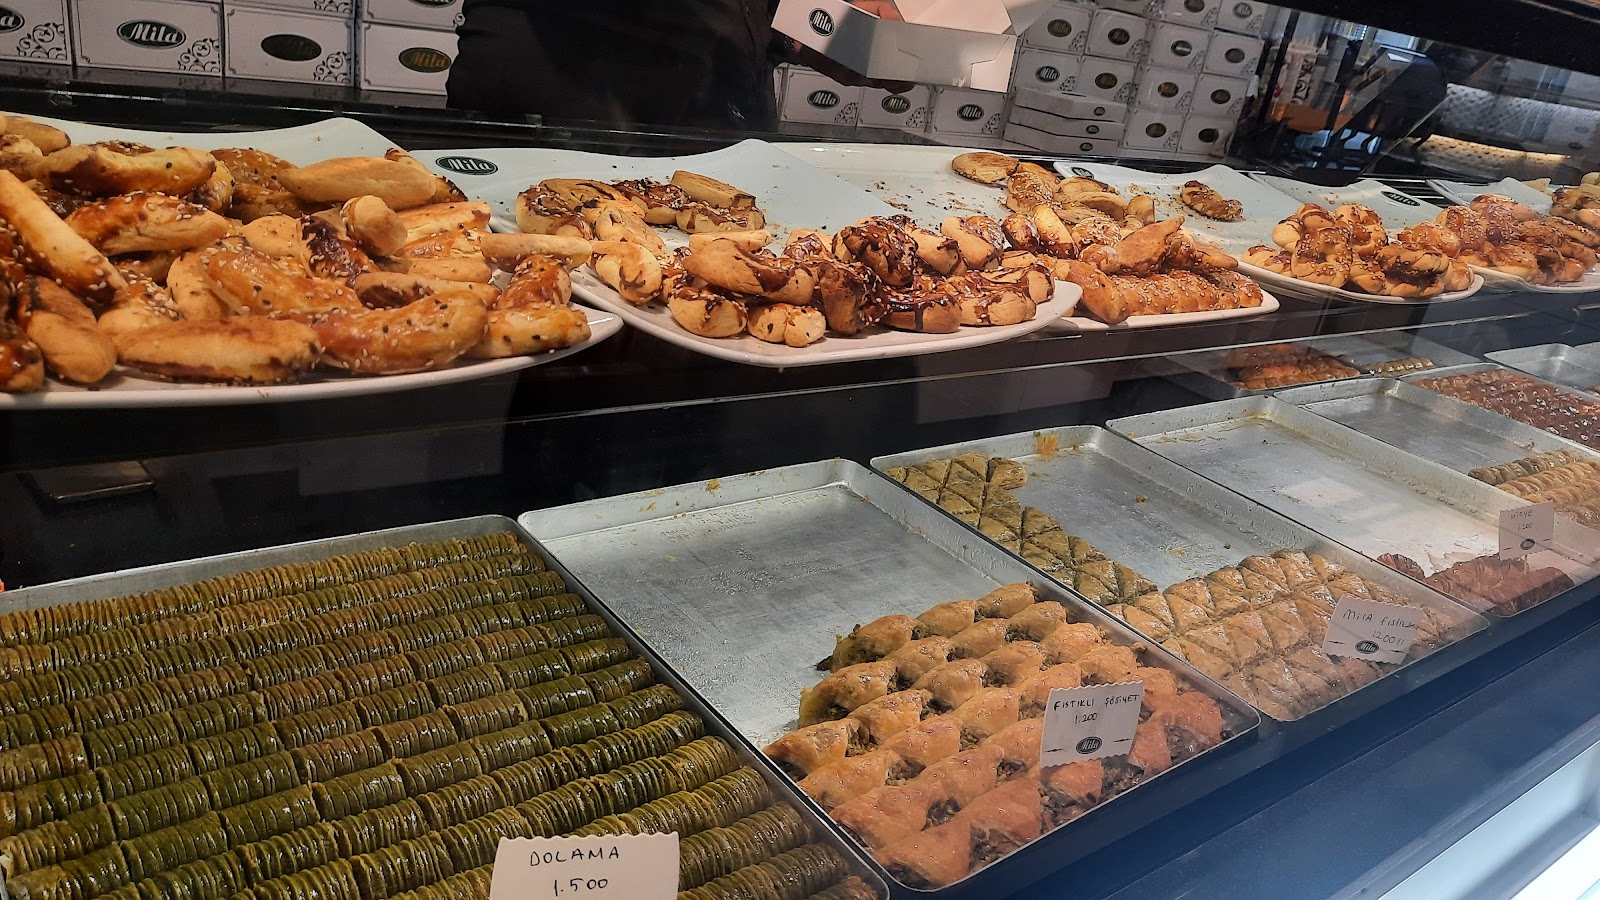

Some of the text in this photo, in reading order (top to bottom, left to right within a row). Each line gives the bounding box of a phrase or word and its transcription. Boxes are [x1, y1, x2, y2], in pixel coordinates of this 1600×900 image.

[812, 11, 832, 32] Mila
[130, 23, 179, 43] Mila
[411, 51, 448, 68] Mila
[1040, 67, 1058, 79] Mila
[813, 92, 838, 105] Mila
[888, 98, 909, 109] Mila
[962, 105, 981, 118] Mila
[447, 158, 491, 171] Mila
[1359, 641, 1376, 651] Mila
[1053, 698, 1095, 711] FISTIKLI
[1075, 712, 1098, 724] 1.200
[1081, 739, 1099, 750] Mila
[529, 846, 620, 867] DOLAMA
[553, 877, 609, 897] 1.500
